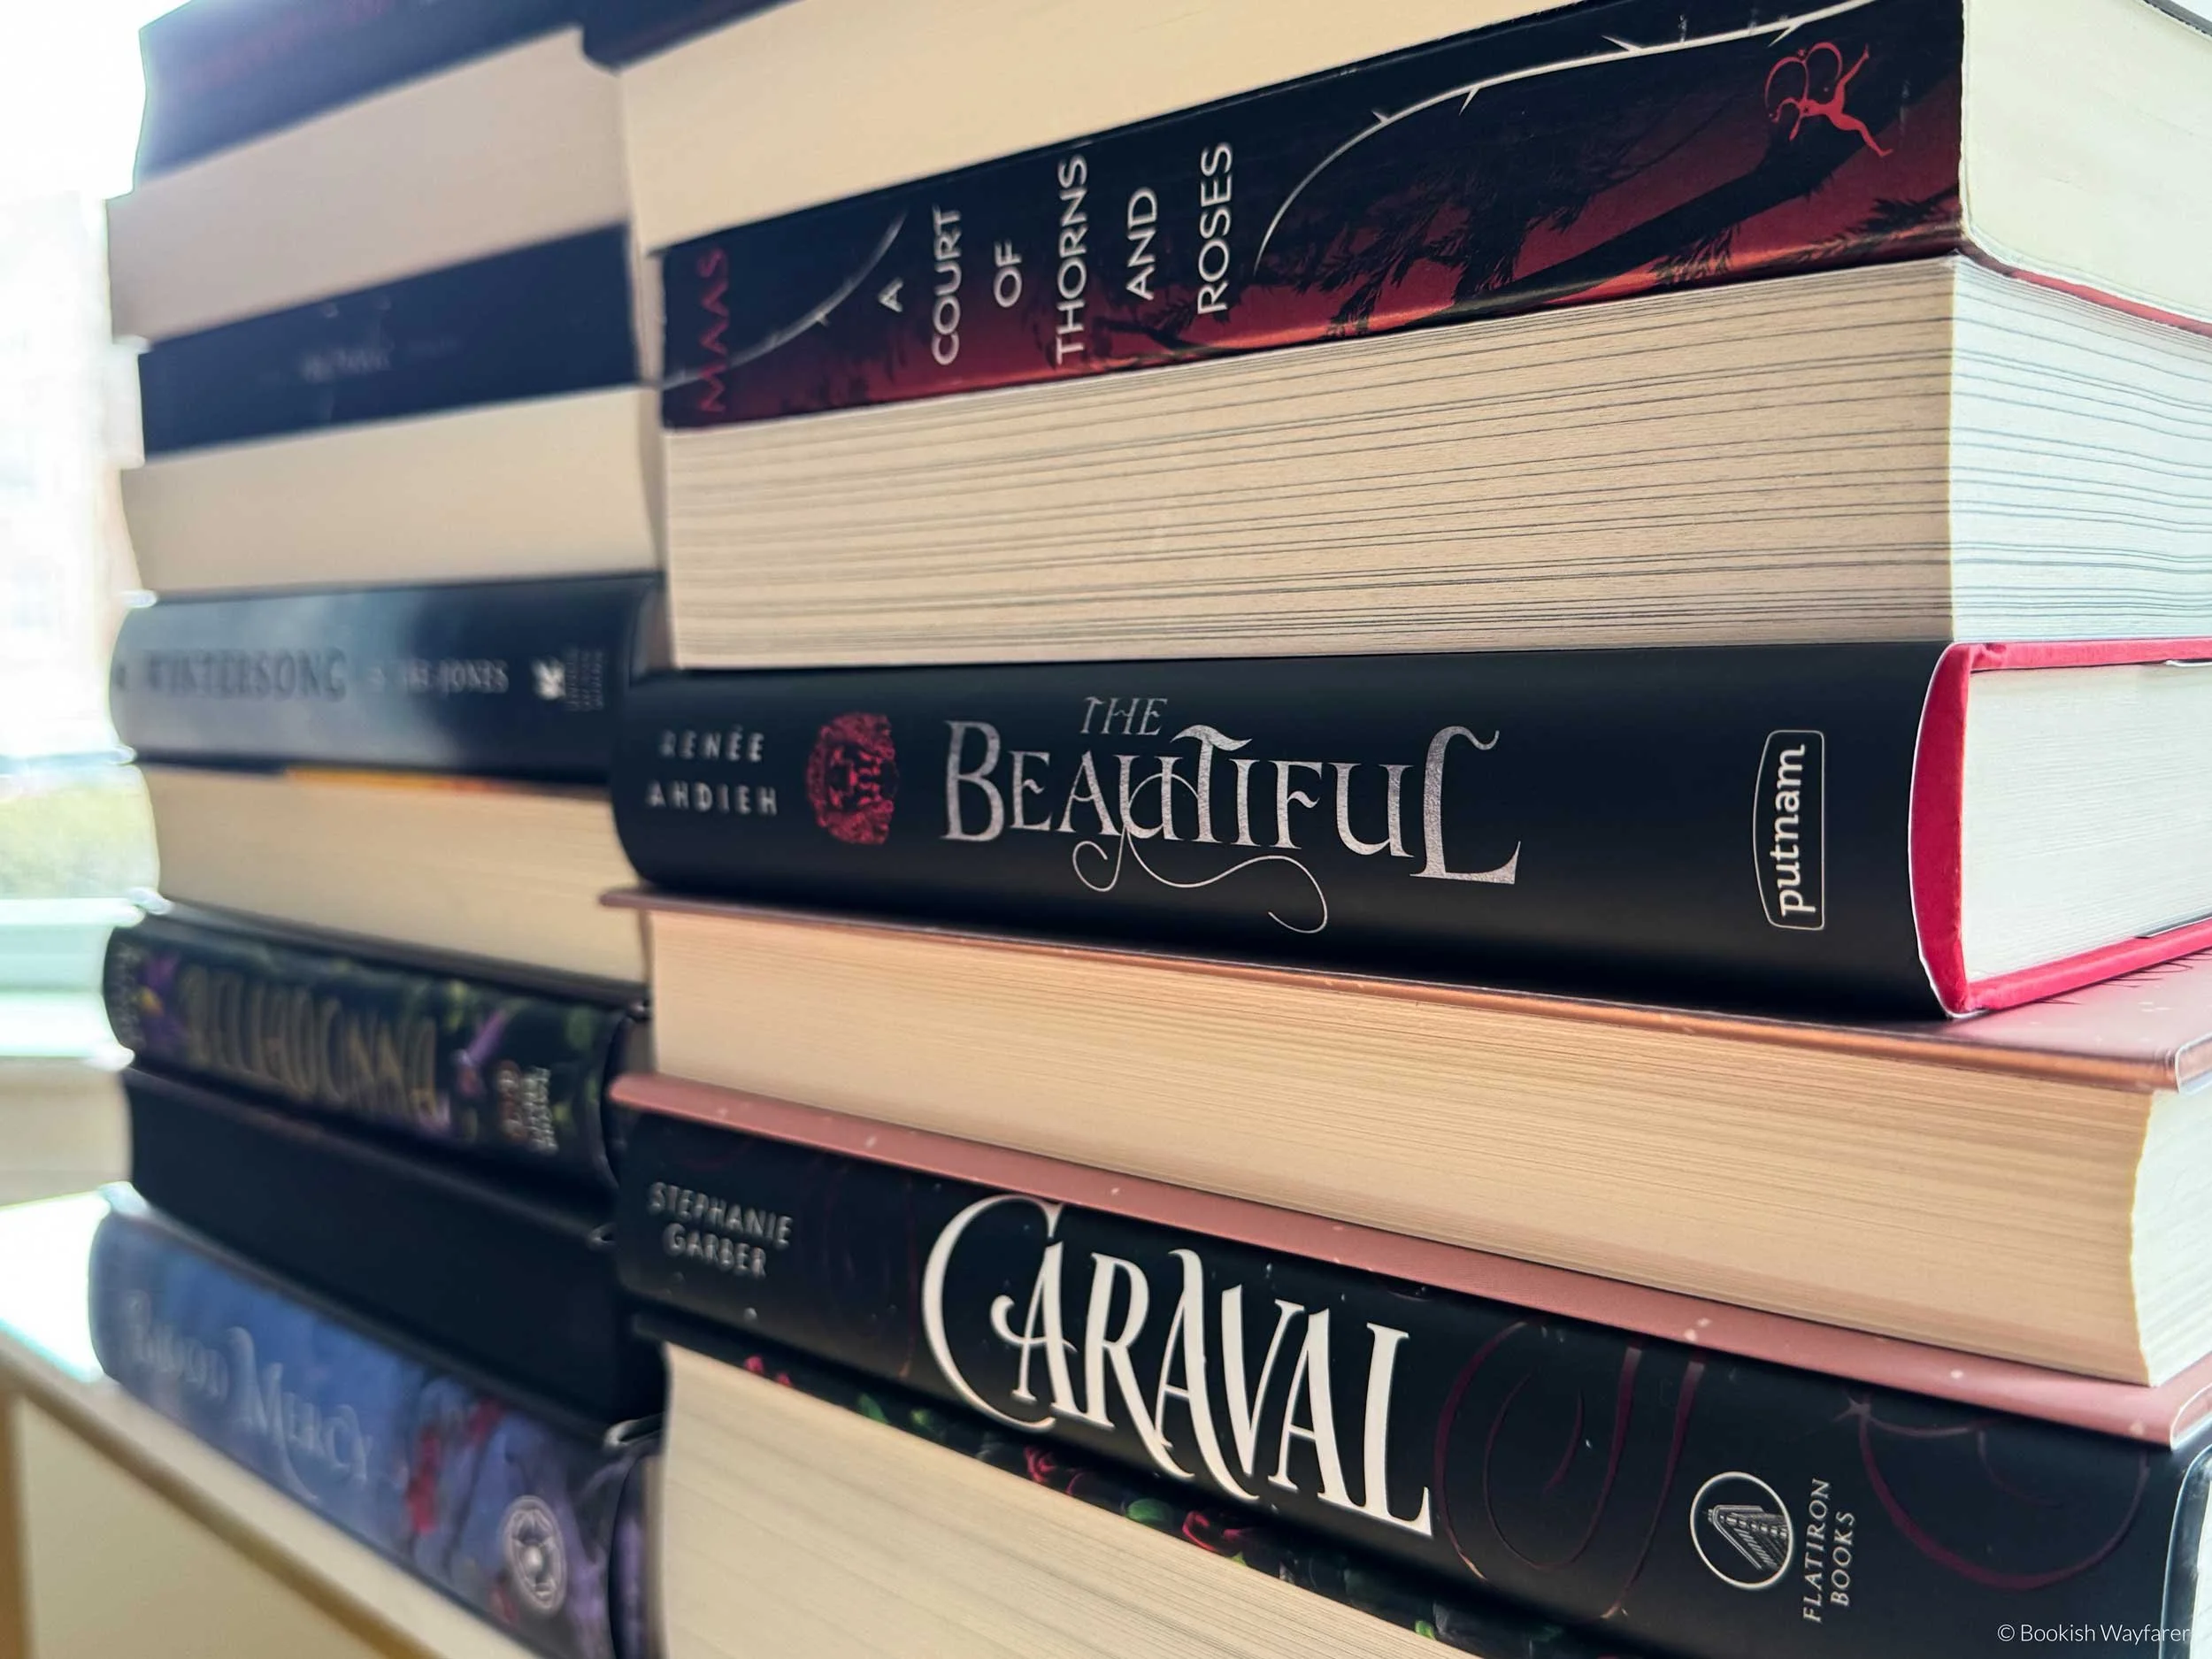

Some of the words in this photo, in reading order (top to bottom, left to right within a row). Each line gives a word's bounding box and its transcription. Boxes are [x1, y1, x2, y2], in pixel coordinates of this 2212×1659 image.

[994, 239, 1023, 308] OF
[1056, 154, 1087, 365] THORNS
[1126, 187, 1158, 301] AND
[1196, 142, 1233, 314] ROSES
[697, 248, 732, 413] MAAS
[879, 277, 904, 313] A
[932, 204, 962, 365] COURT
[658, 726, 765, 763] RENÉE
[1081, 695, 1168, 736] THE
[645, 780, 779, 816] AHDIEH
[1770, 743, 1816, 918] putnam
[647, 1180, 795, 1252] STEPHANIE
[664, 1222, 768, 1280] GARBER
[921, 1194, 1433, 1538] CARAVAL
[1802, 1477, 1831, 1624] FLATIRON
[1830, 1510, 1856, 1608] BOOKS
